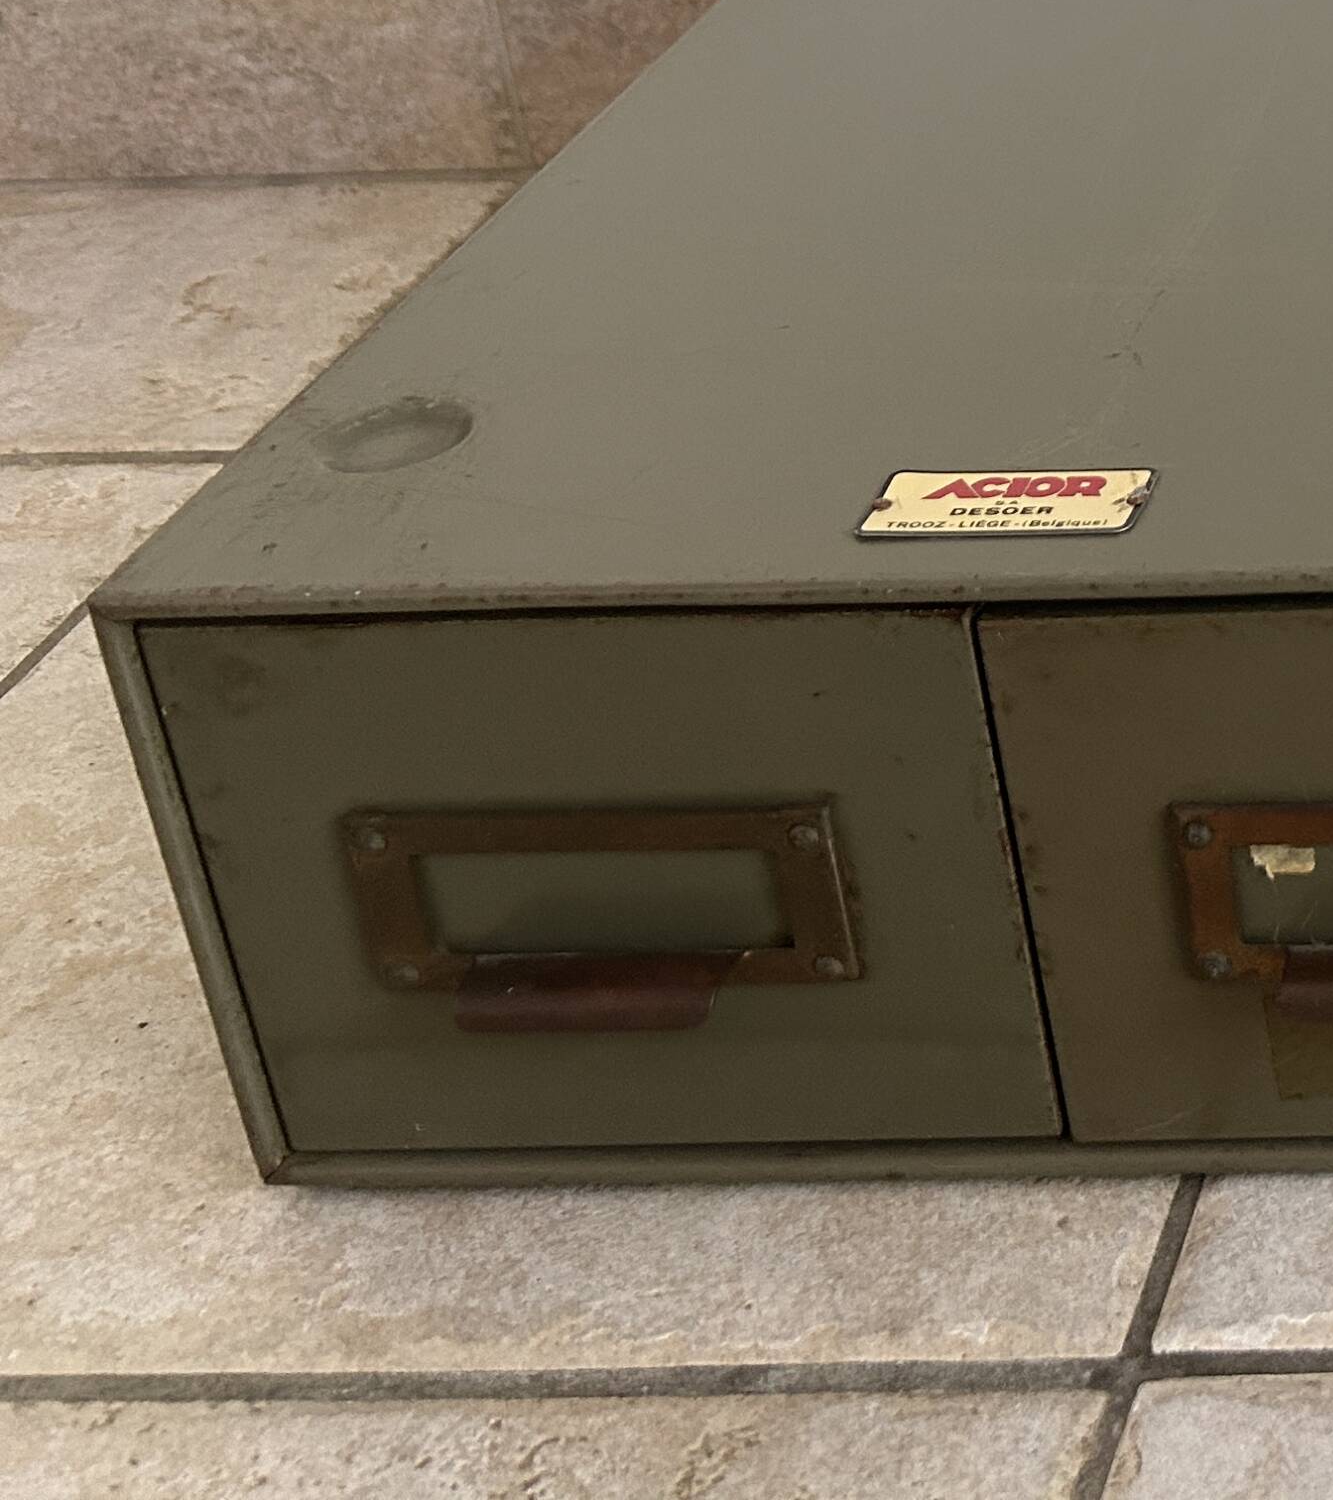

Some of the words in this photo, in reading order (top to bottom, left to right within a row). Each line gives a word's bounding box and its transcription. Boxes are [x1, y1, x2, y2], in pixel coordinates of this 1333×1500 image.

[920, 476, 1108, 500] ACIOR
[949, 506, 1055, 517] DESOER
[886, 520, 946, 529] TROOZ
